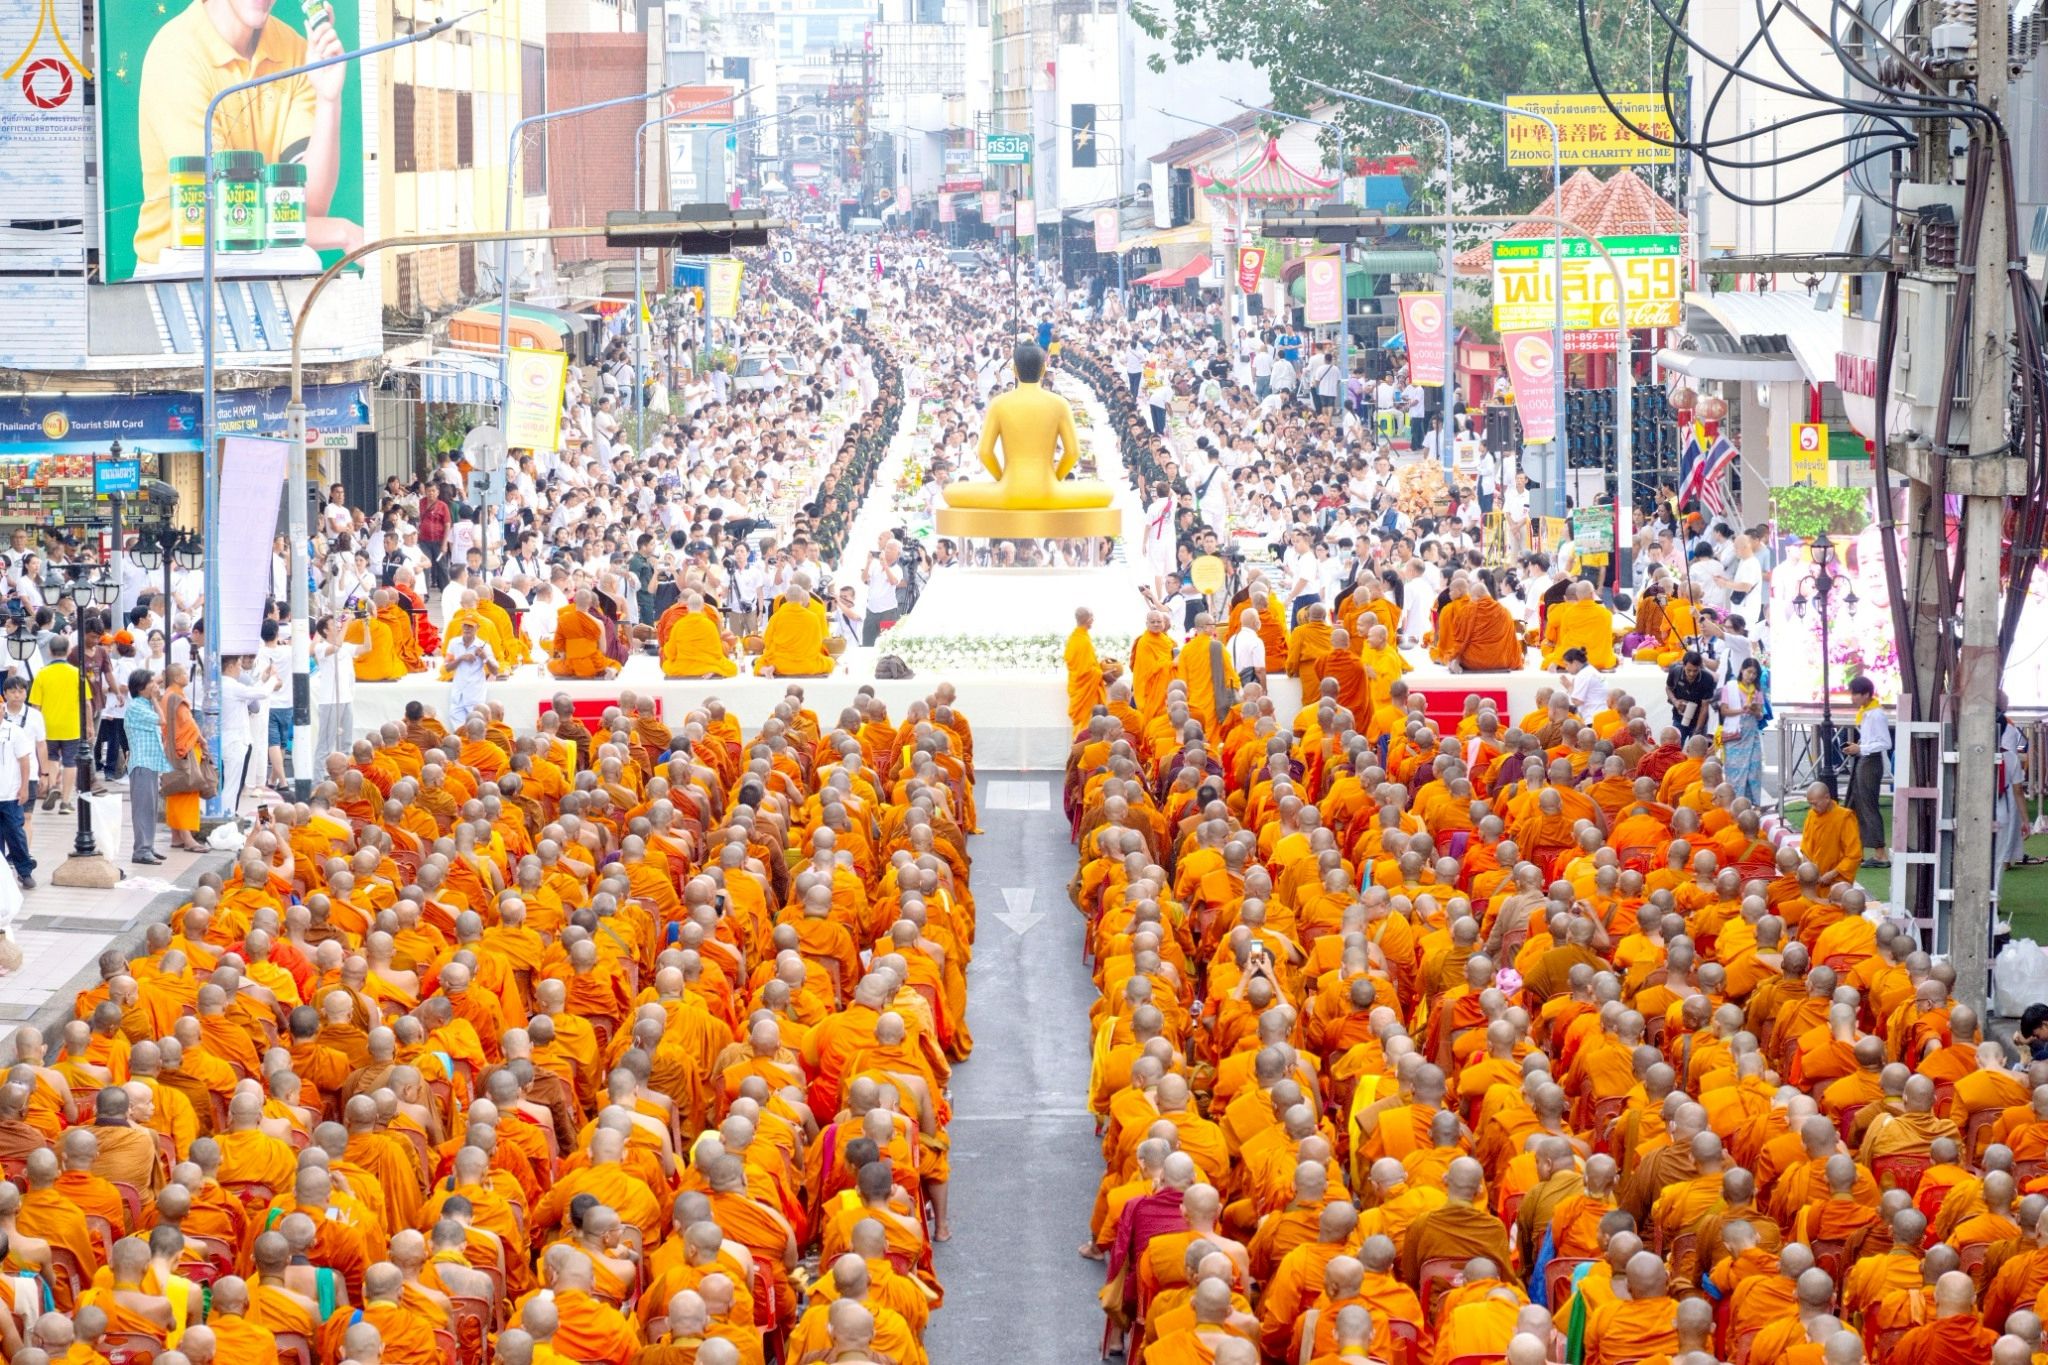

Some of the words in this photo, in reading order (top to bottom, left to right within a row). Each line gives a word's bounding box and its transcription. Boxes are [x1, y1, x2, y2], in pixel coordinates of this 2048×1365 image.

[988, 137, 1029, 153] ศรีวิไล
[1582, 149, 1632, 158] CHARITY
[1637, 148, 1671, 157] HOME
[783, 252, 792, 263] D
[915, 258, 925, 270] A
[72, 421, 102, 430] Tourist
[103, 421, 120, 429] SIM
[122, 420, 144, 429] Card
[218, 421, 245, 432] TOURIST
[246, 420, 258, 429] SIM
